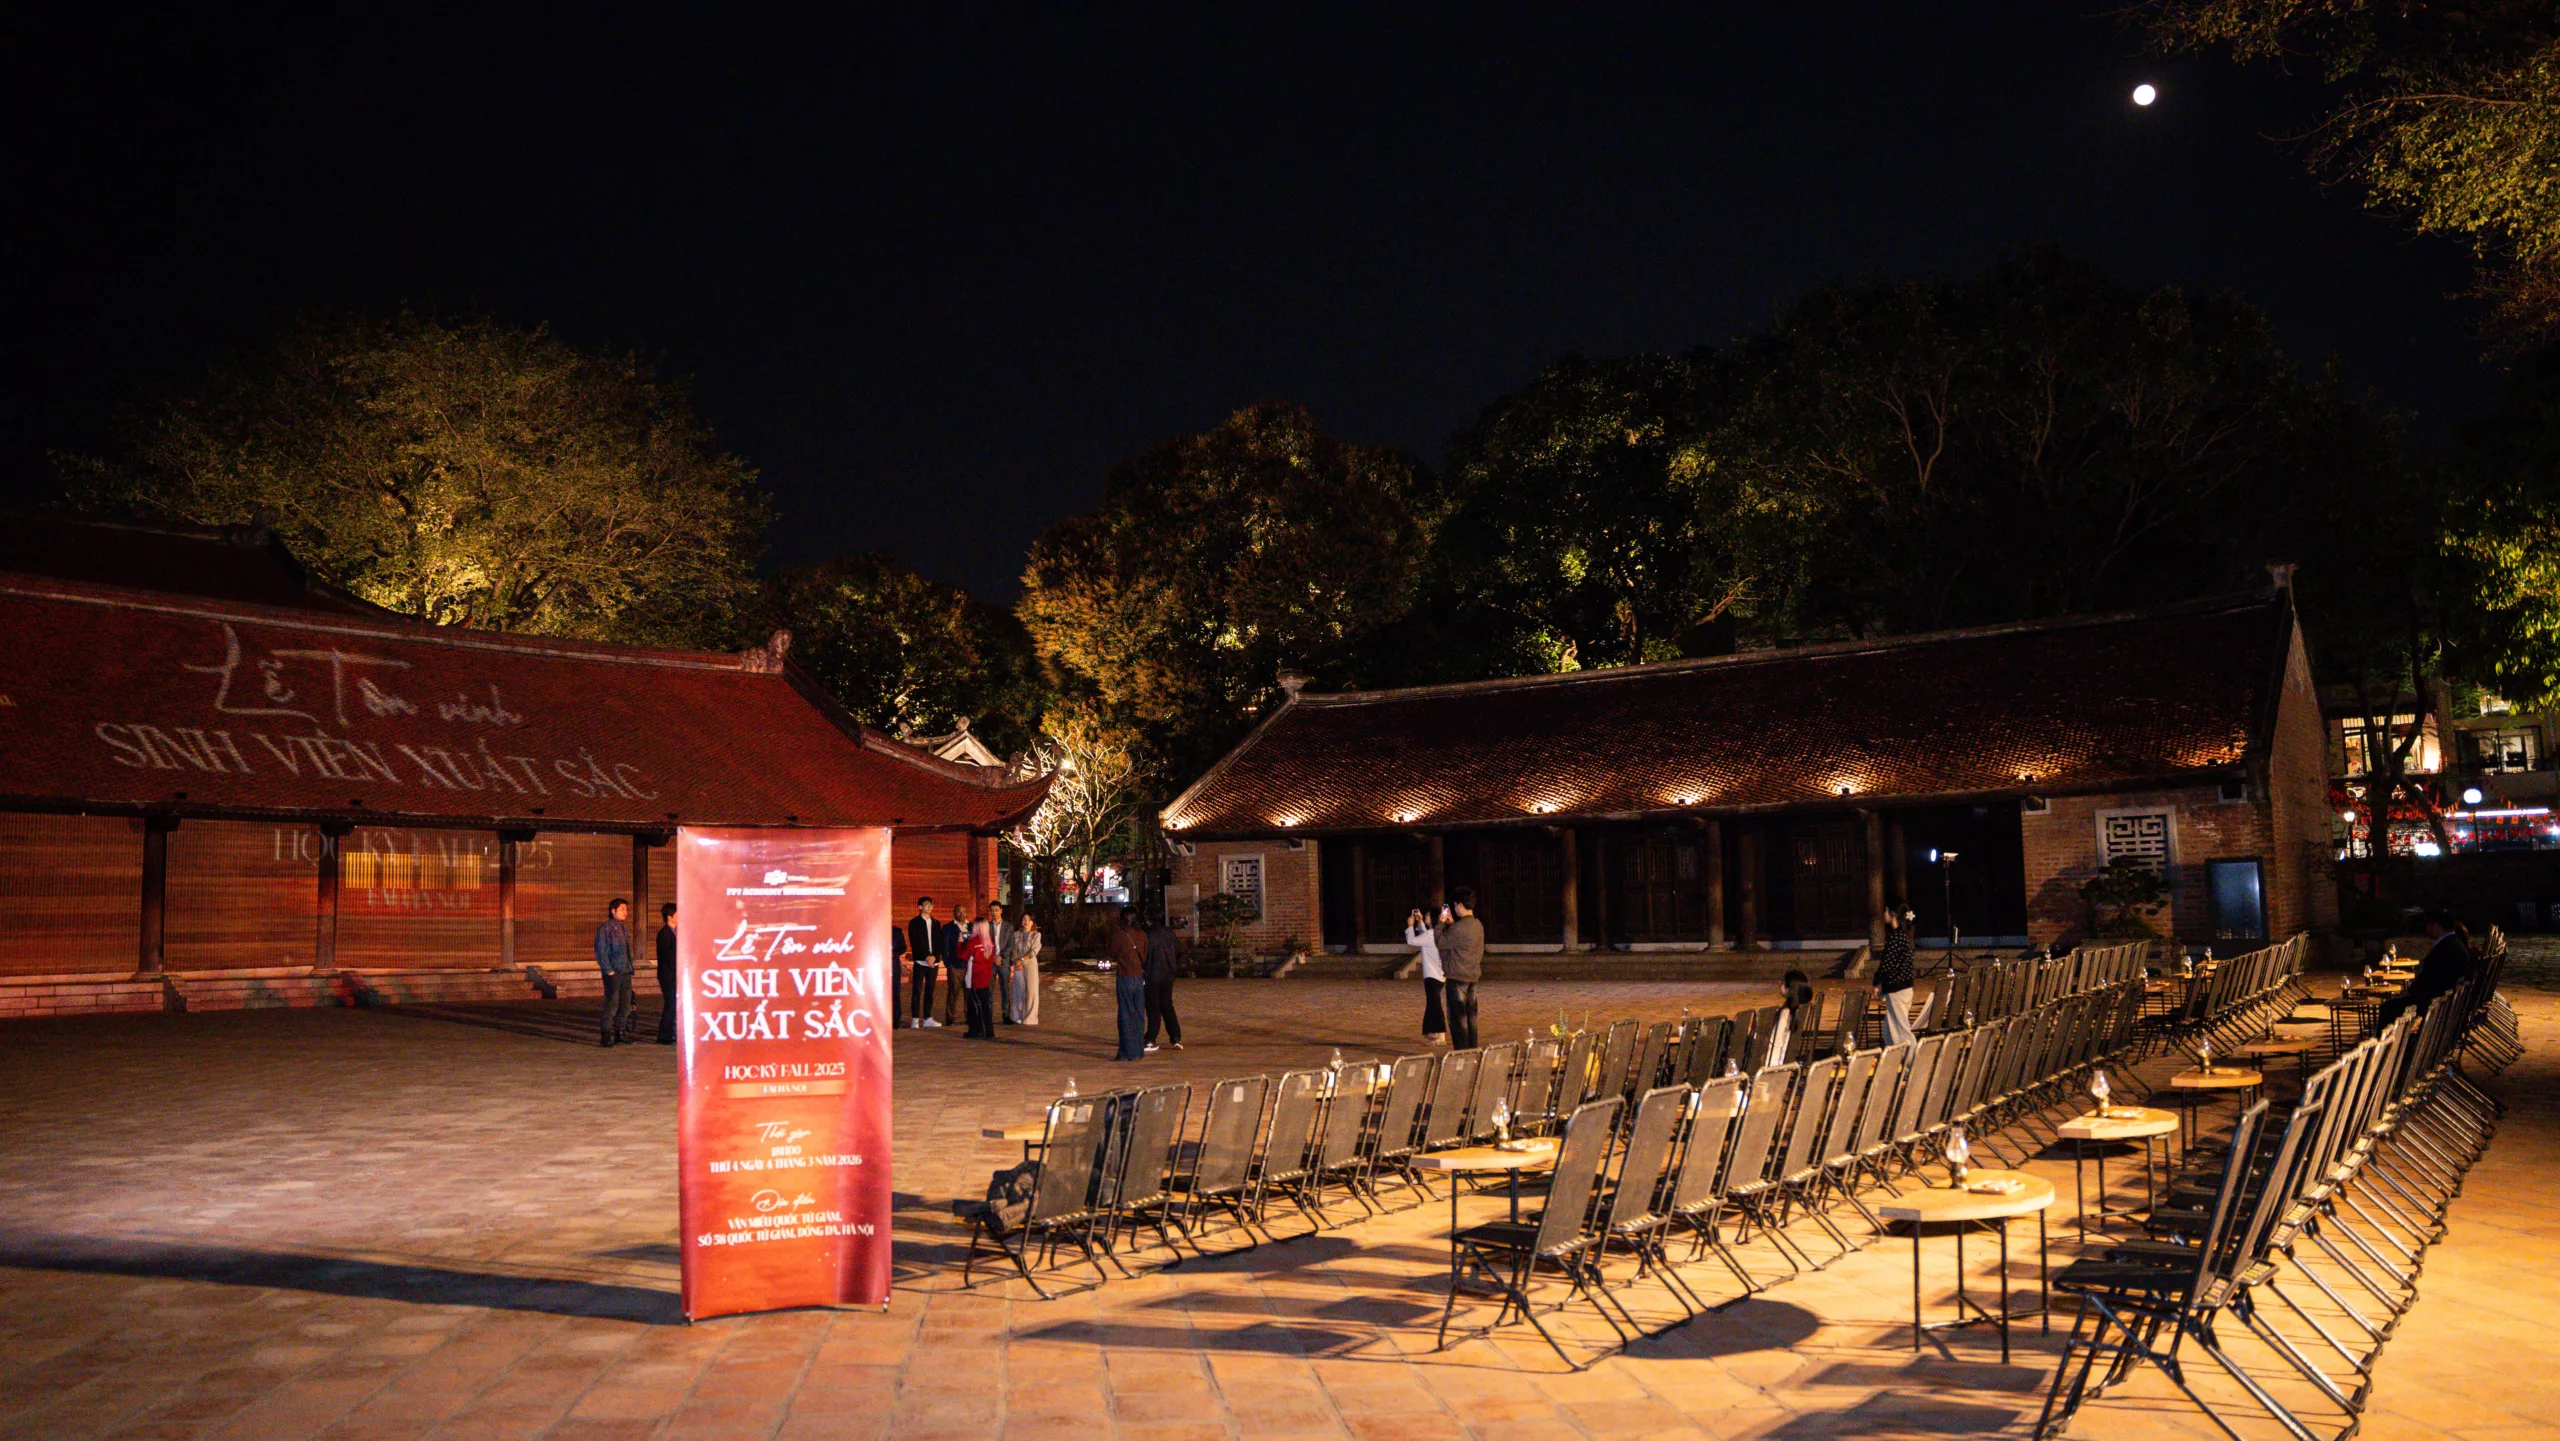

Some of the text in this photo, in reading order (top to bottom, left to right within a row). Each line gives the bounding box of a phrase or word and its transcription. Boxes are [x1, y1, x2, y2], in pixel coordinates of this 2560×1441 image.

[184, 623, 319, 722] Lễ
[95, 722, 658, 801] SINH VIÊN XUẤT SẮC
[714, 919, 855, 962] Lễ Tôn vinh
[701, 961, 865, 998] SINH VIÊN
[700, 999, 872, 1041] XUẤT SẮC
[724, 1064, 760, 1081] HỌC
[781, 1062, 812, 1078] FALL
[814, 1060, 846, 1077] 2025
[732, 1160, 739, 1172] 4
[766, 1158, 773, 1170] 4
[808, 1156, 814, 1167] 3
[837, 1154, 863, 1166] 2026
